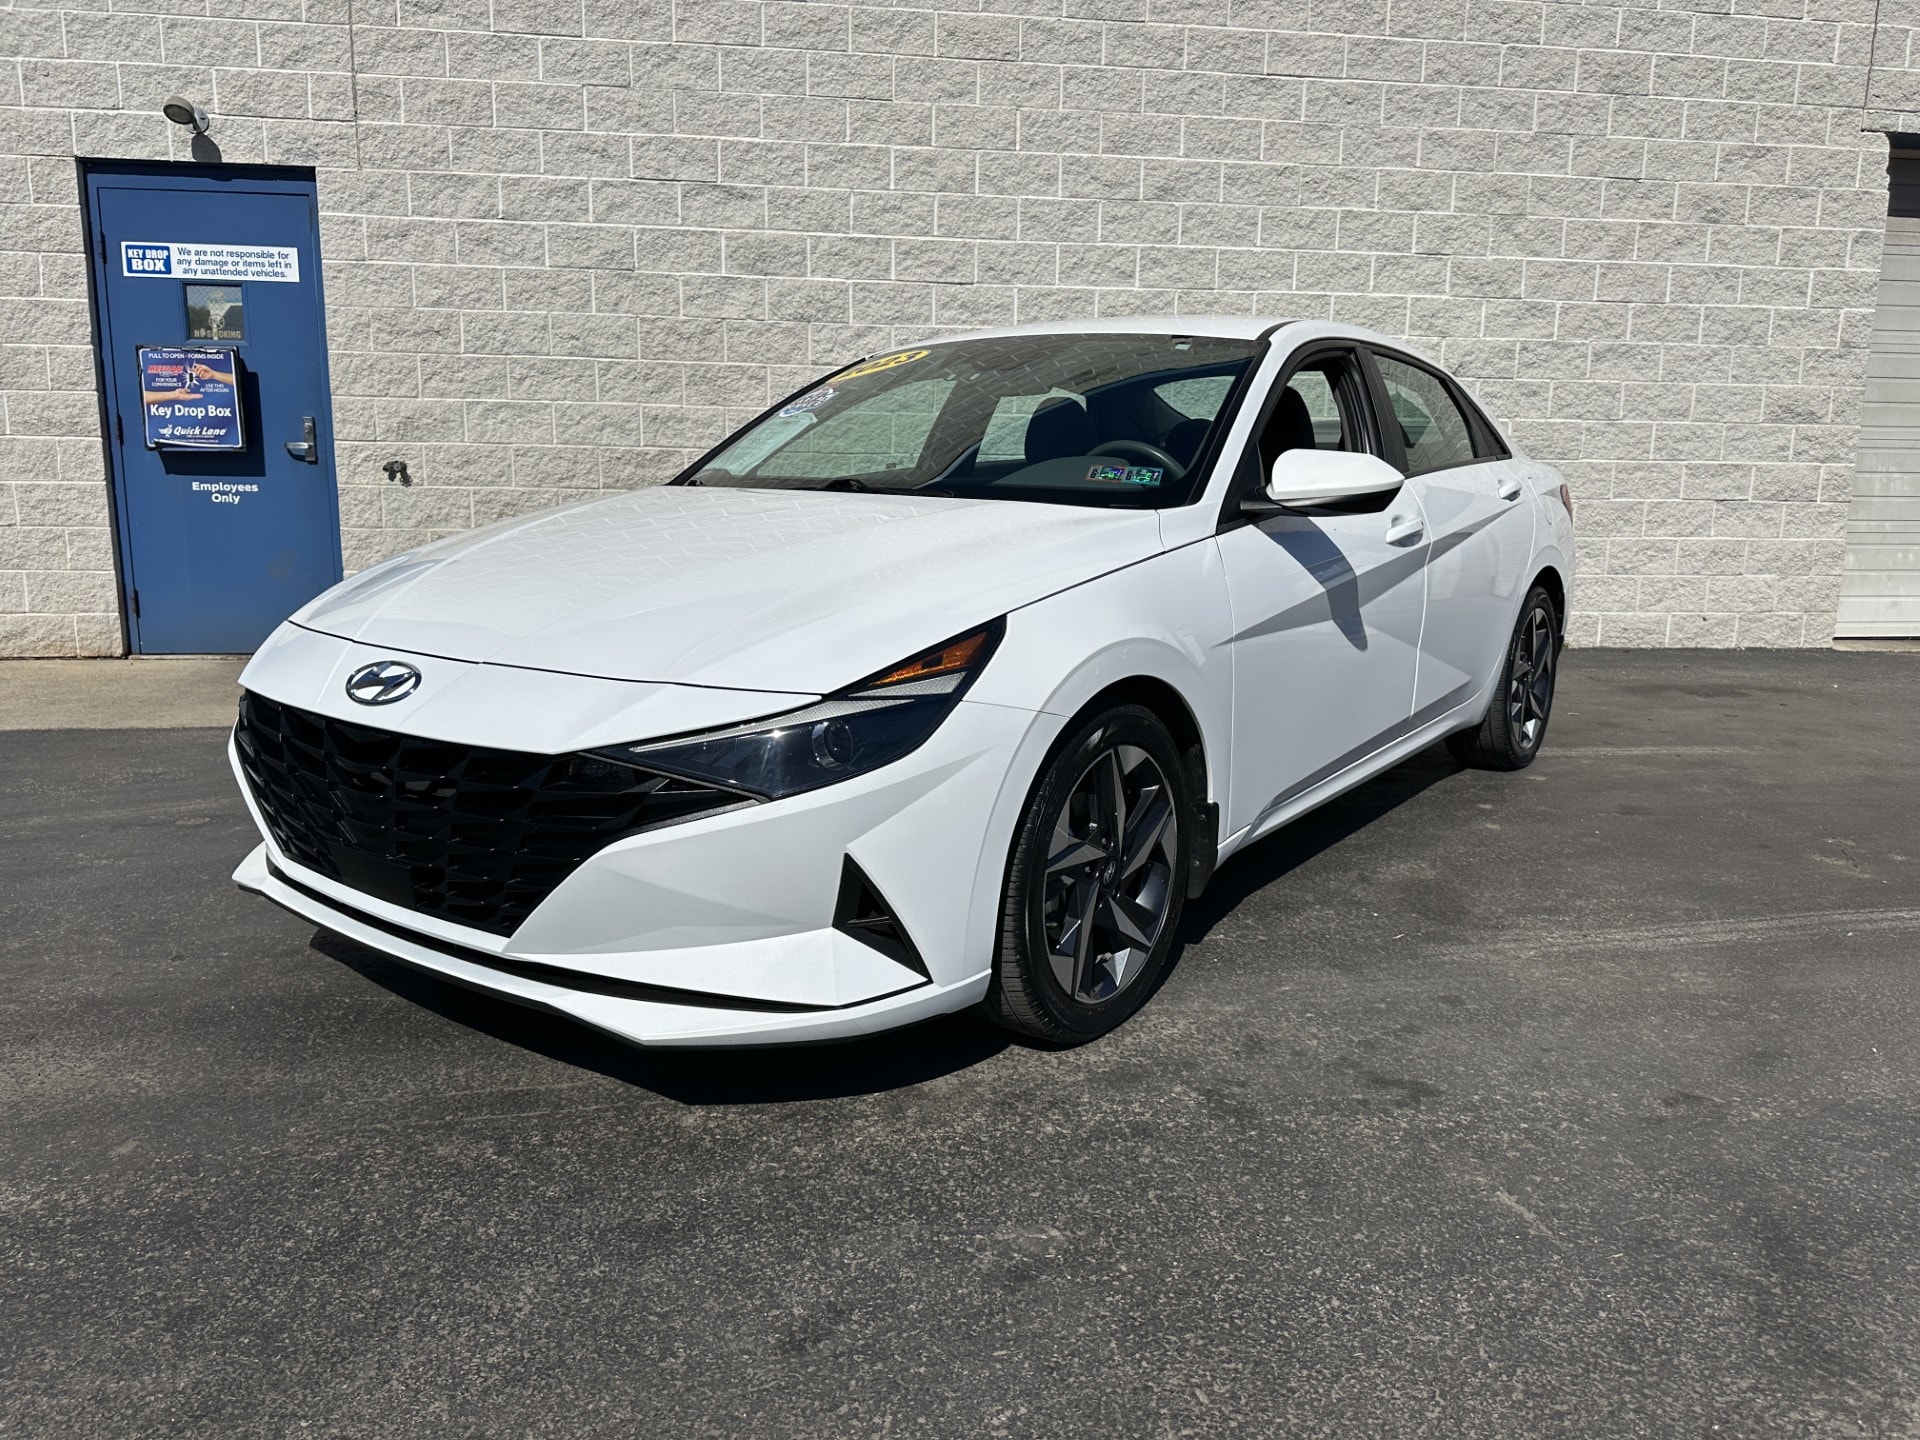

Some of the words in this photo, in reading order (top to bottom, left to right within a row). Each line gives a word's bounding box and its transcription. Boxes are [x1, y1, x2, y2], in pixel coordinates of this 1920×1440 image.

[127, 248, 144, 259] KEY
[145, 249, 169, 260] DROP
[177, 247, 192, 256] We
[194, 249, 209, 257] are
[210, 249, 224, 257] not
[226, 250, 275, 260] responsible
[278, 251, 290, 260] for
[131, 259, 167, 272] BOX
[176, 258, 192, 267] any
[195, 257, 229, 269] damage
[242, 259, 266, 268] items
[268, 260, 282, 268] left
[284, 261, 292, 269] in
[182, 268, 198, 277] any
[200, 267, 249, 277] unattended
[251, 269, 287, 278] vehicles.
[150, 404, 172, 419] Key
[174, 404, 206, 420] Drop
[207, 404, 232, 417] Box
[173, 425, 201, 436] Quick
[201, 426, 227, 436] Lane
[191, 481, 259, 493] Employees
[211, 493, 241, 505] Only
